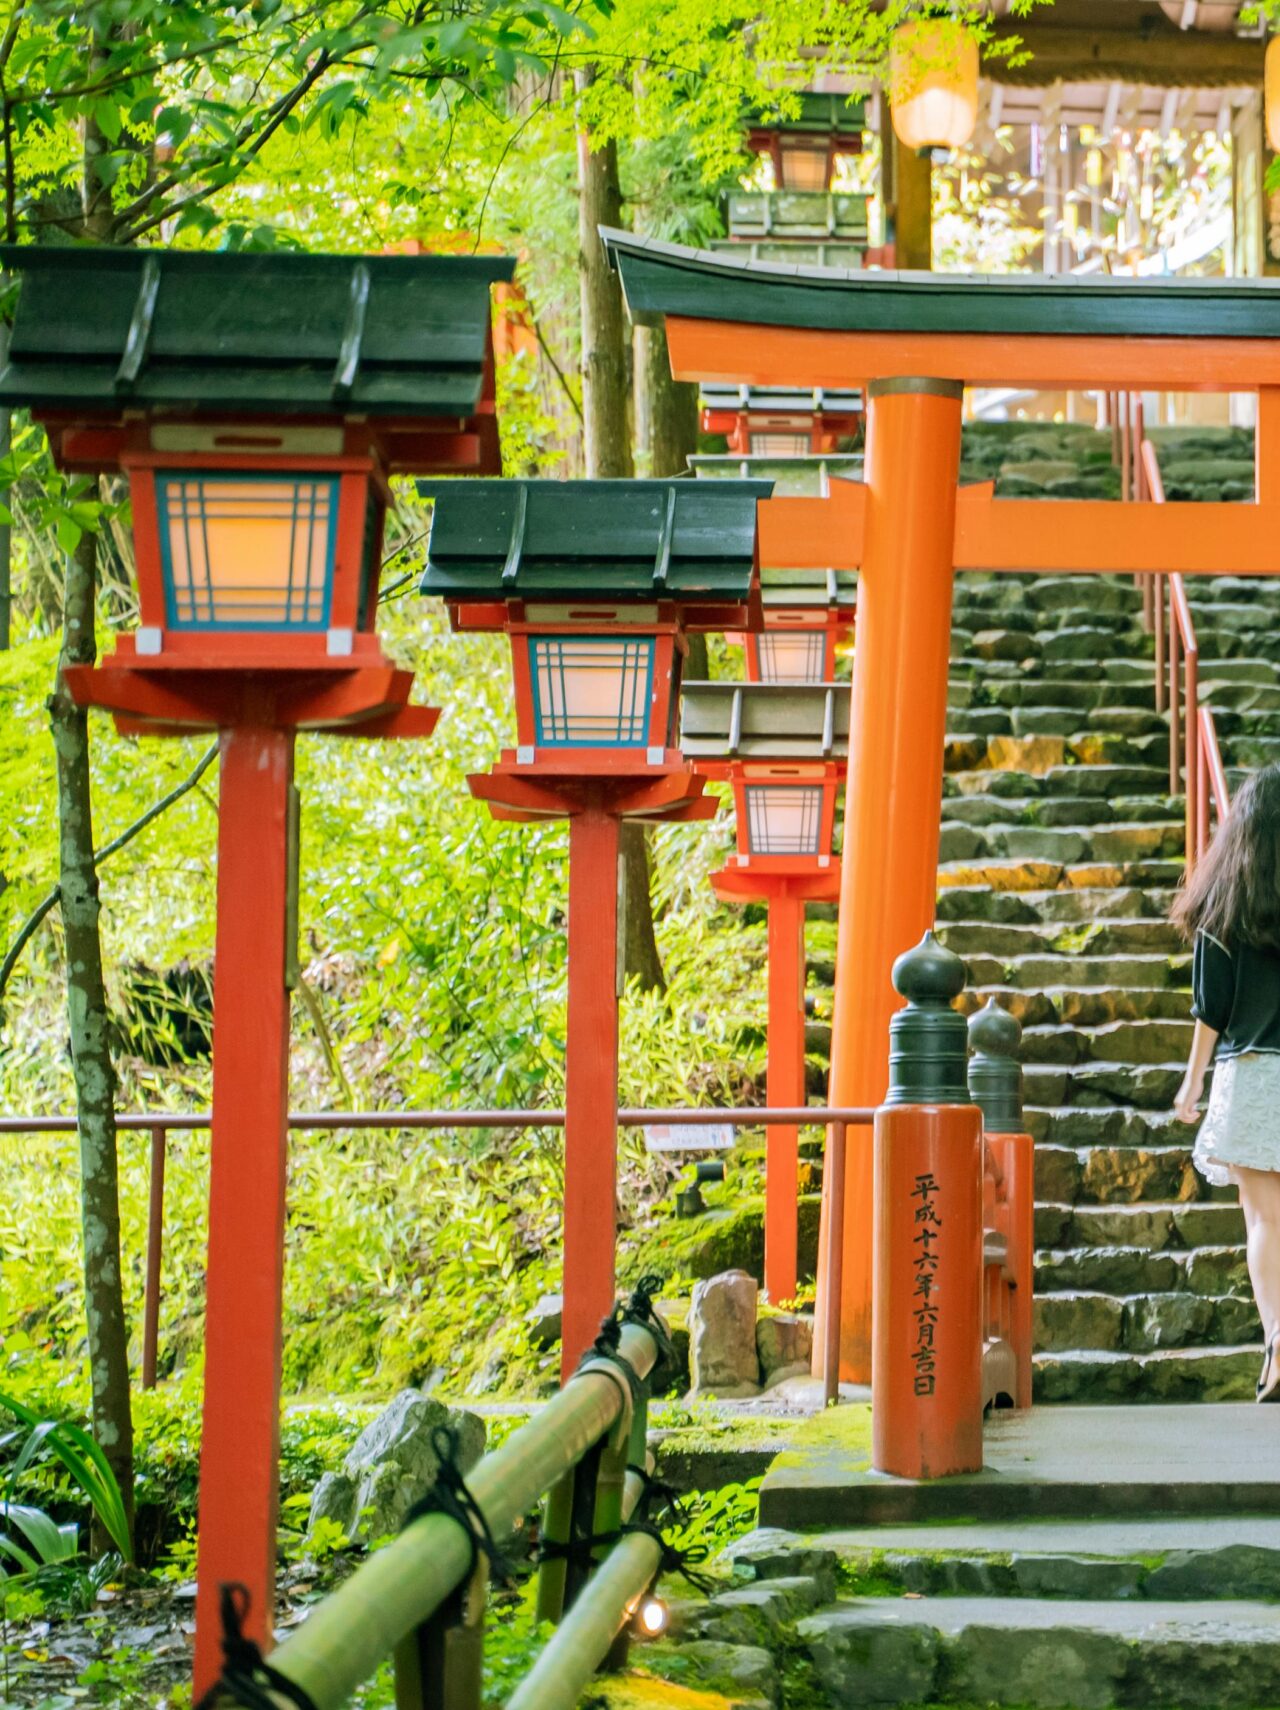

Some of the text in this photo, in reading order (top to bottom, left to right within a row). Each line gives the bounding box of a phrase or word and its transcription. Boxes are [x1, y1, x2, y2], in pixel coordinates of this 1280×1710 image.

[910, 1173, 942, 1397] 平成十六年六月吉日
